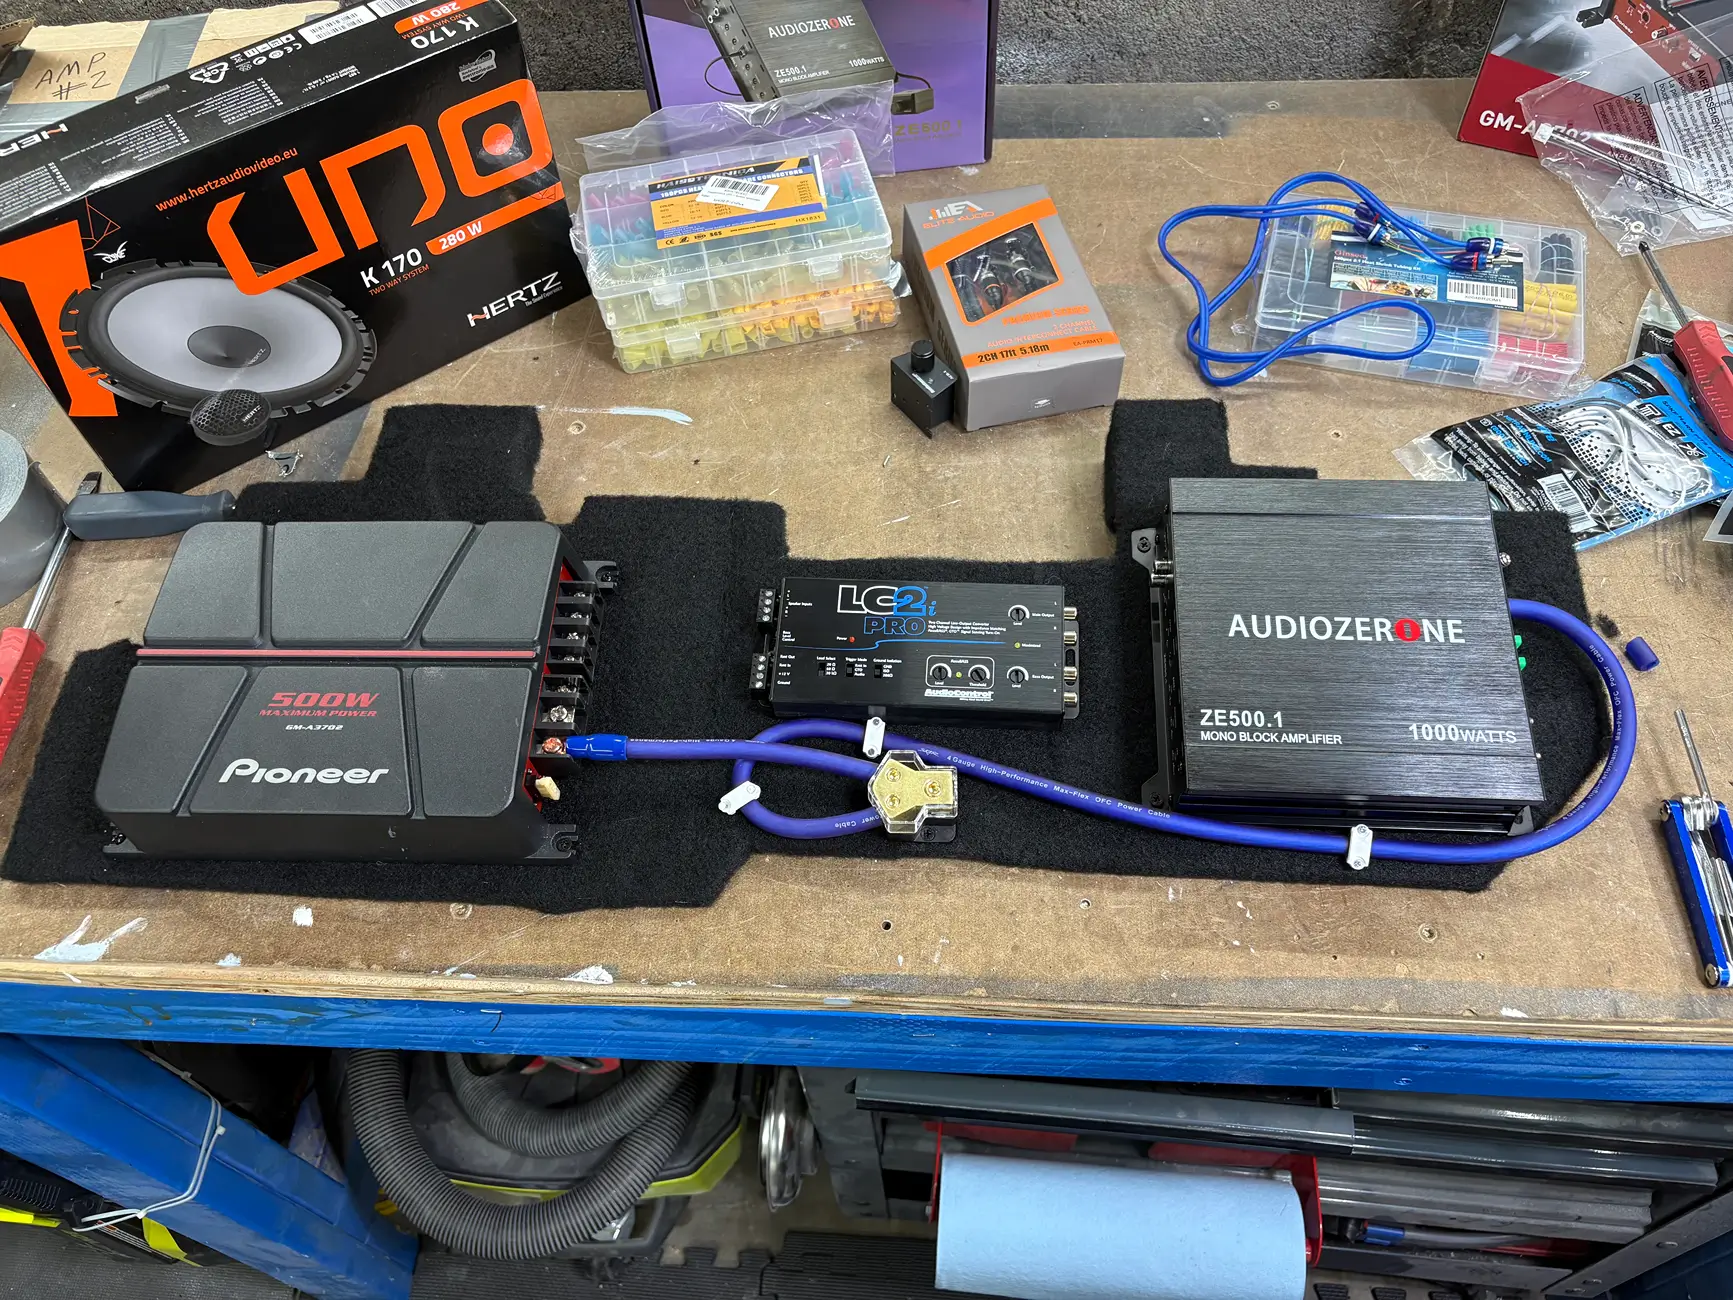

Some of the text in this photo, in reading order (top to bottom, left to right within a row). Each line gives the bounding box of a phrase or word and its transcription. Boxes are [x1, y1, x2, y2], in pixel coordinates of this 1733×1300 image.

[401, 12, 469, 41] TWO WAY SYSTEM
[411, 12, 431, 26] W
[768, 15, 856, 39] AUDIOZERONE
[1614, 14, 1634, 35] Pioneer
[411, 16, 480, 50] K 170
[34, 52, 107, 90] AMP
[774, 66, 808, 79] ZE500.1
[778, 75, 793, 84] MONO
[805, 69, 831, 80] AMPLIFIER
[51, 71, 112, 100] #2
[155, 147, 298, 212] www.hertzaudiovideo.eu
[756, 168, 804, 181] CONNECTORS
[438, 221, 484, 251] 280 W
[360, 247, 424, 289] K 170
[1363, 258, 1376, 266] Heat
[1391, 262, 1410, 271] Tubing
[368, 263, 431, 297] TWO WAY SYSTEM
[466, 271, 563, 328] HERTZ
[1053, 304, 1090, 317] SERIES
[1060, 319, 1095, 330] CHANNEL
[978, 351, 998, 364] 2CH
[1020, 343, 1050, 355] 5.18m
[242, 404, 263, 423] HERTZ
[1662, 420, 1679, 437] EZ
[836, 584, 937, 617] LC2i
[863, 616, 926, 636] PRO
[1228, 614, 1466, 644] AUDIOZERONE
[1589, 643, 1603, 664] Cable
[1604, 664, 1615, 688] Power
[267, 692, 380, 708] 500W
[924, 688, 994, 699] AudioControl
[1613, 689, 1621, 707] OFC
[259, 709, 377, 717] MAXIMUM POWER
[1200, 709, 1284, 729] ZE500.1
[1613, 709, 1624, 741] Max-Flex
[1200, 731, 1343, 746] MONO BLOCK AMPLIFIER
[218, 758, 390, 785] Pioneer
[980, 764, 1049, 790] High-Performance
[1053, 784, 1091, 801] Max-Flex
[1094, 796, 1113, 807] OFC
[1117, 802, 1143, 813] Power
[1147, 808, 1172, 820] Cable
[834, 814, 883, 829] ower Cable
